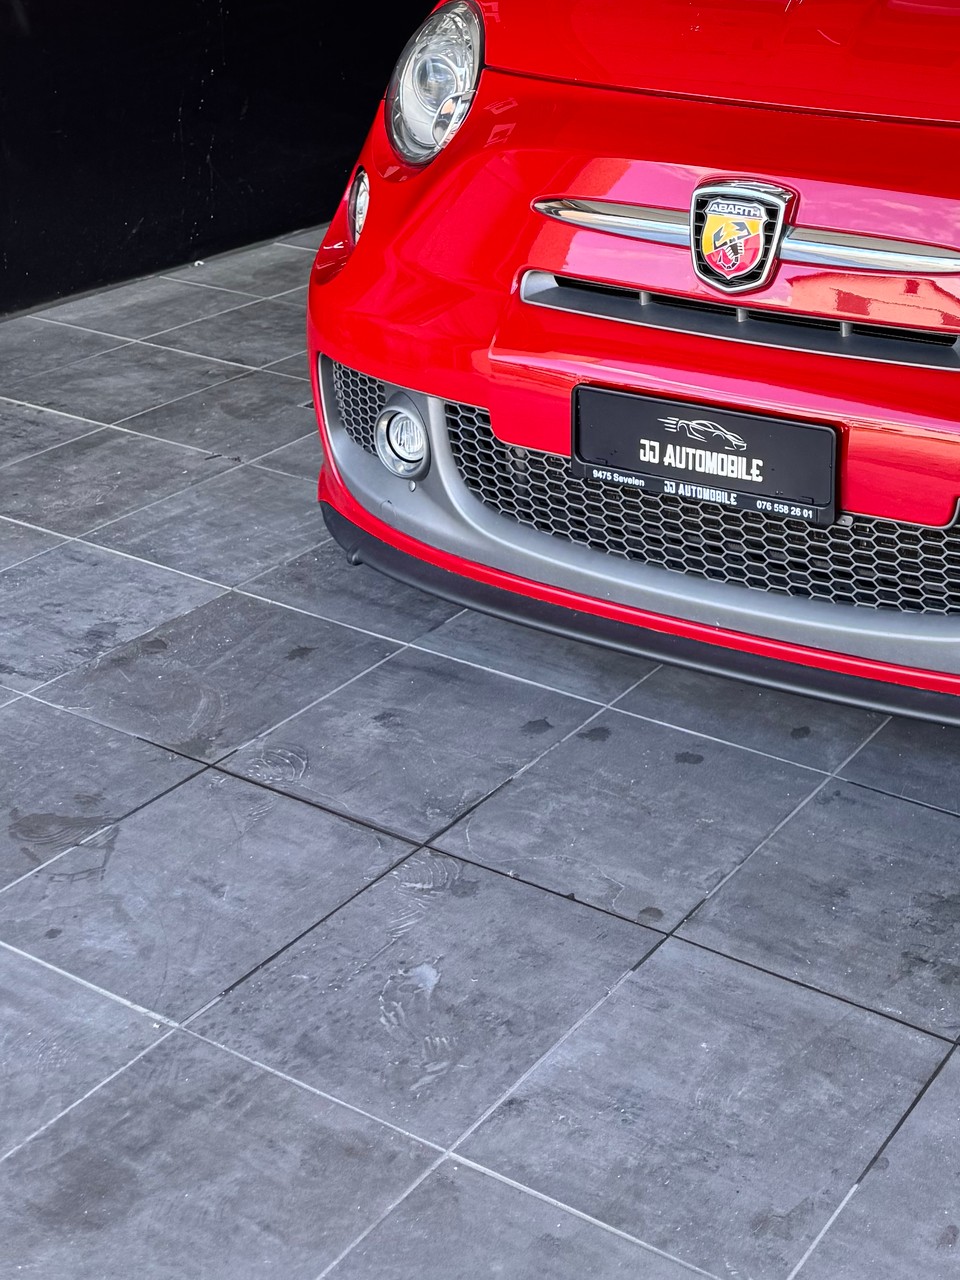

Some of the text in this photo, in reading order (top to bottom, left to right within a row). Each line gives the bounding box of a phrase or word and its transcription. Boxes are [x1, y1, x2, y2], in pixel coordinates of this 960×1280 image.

[710, 203, 760, 218] ABARTH
[639, 438, 763, 482] JJ AUTOMOBILE
[592, 469, 645, 487] 9475 Sevelen
[678, 483, 738, 506] AUTOMOBILE
[756, 500, 813, 519] 076 558 26 01
